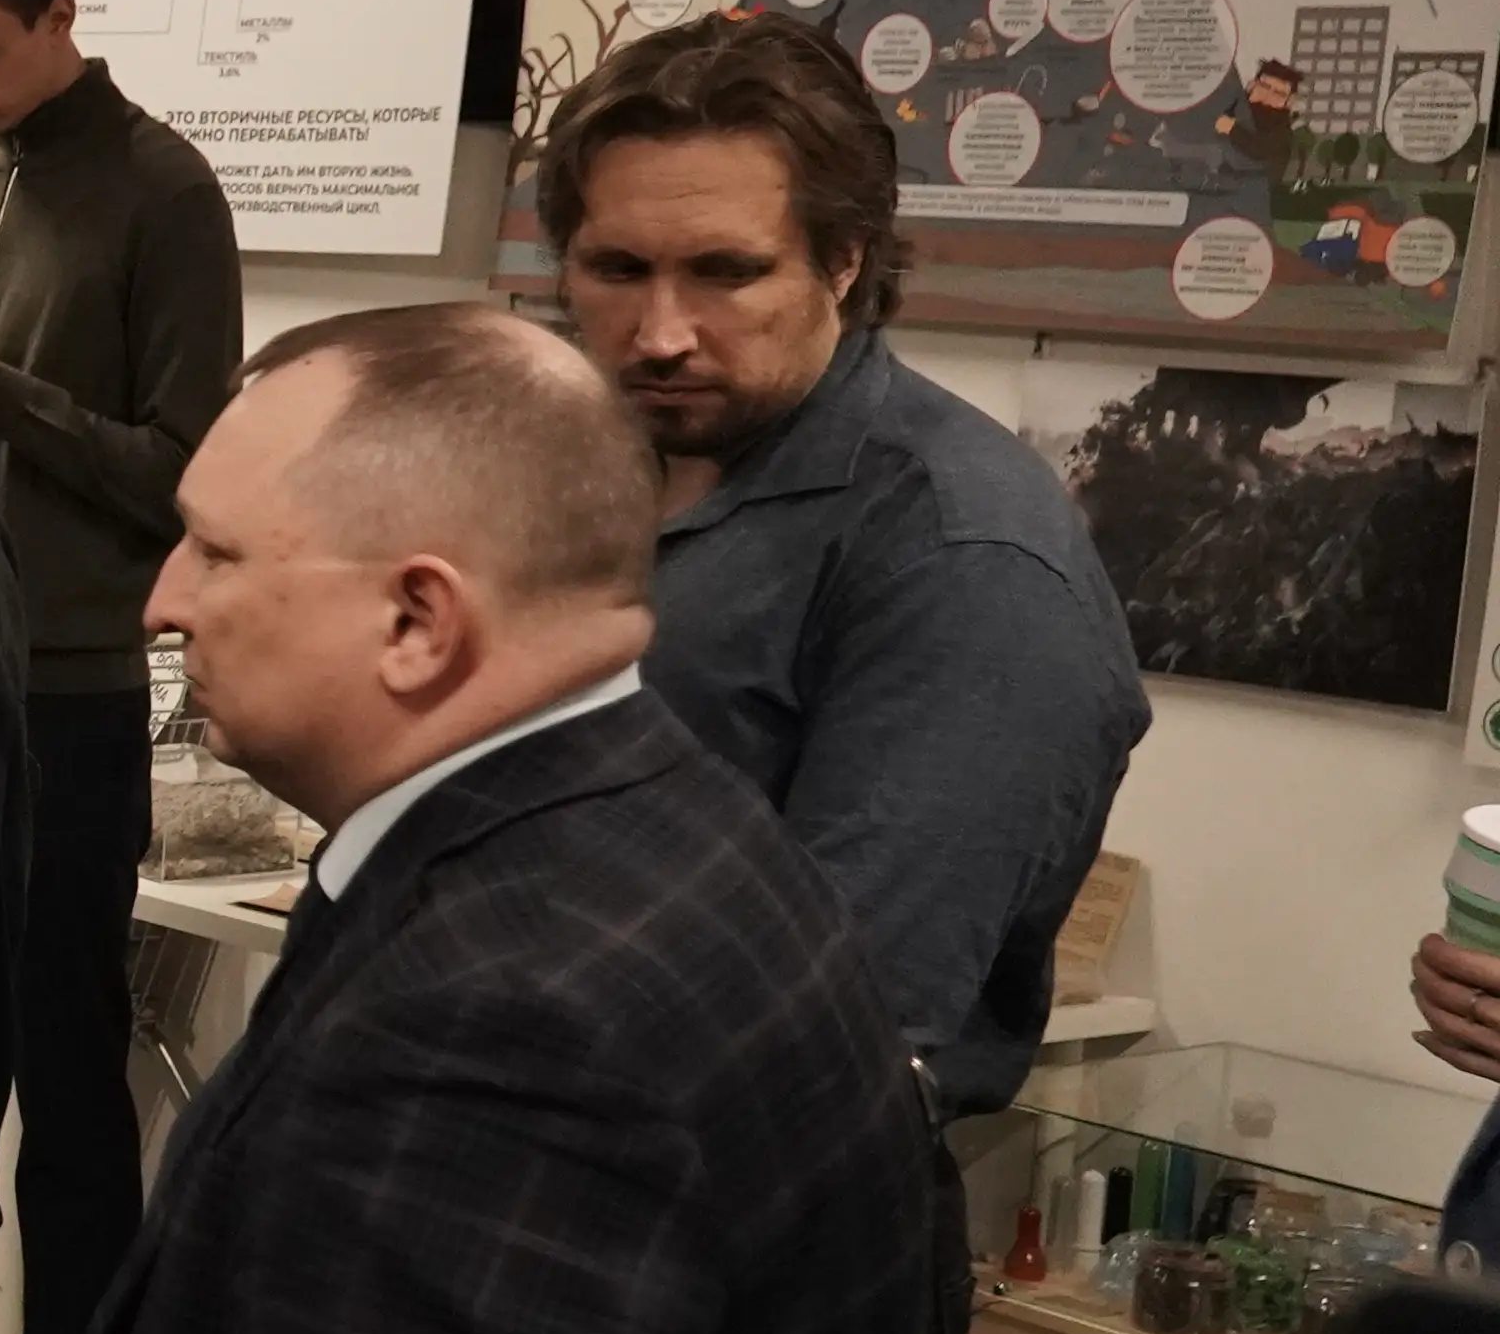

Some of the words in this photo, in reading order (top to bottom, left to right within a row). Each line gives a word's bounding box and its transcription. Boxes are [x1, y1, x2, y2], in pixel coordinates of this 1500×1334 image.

[165, 110, 195, 124] ЭТО
[200, 110, 293, 124] ВТОРИЧНЫЕ
[298, 109, 369, 124] РЕСУРСЫ,
[373, 106, 443, 122] КОТОРЫЕ
[229, 127, 370, 143] ПЕРЕРАБАТЫВАТЬ!
[215, 165, 260, 177] МОЖЕТ
[262, 165, 293, 178] ДАТЬ
[297, 165, 316, 177] ИМ
[319, 165, 367, 177] ВТОРУЮ
[220, 184, 263, 195] ПОСОБ
[266, 183, 319, 195] ВЕРНУТЬ
[322, 183, 420, 196] МАКСИМАЛЬНОЕ
[229, 199, 343, 214] ОИЗВОДСТВЕННЫЙ
